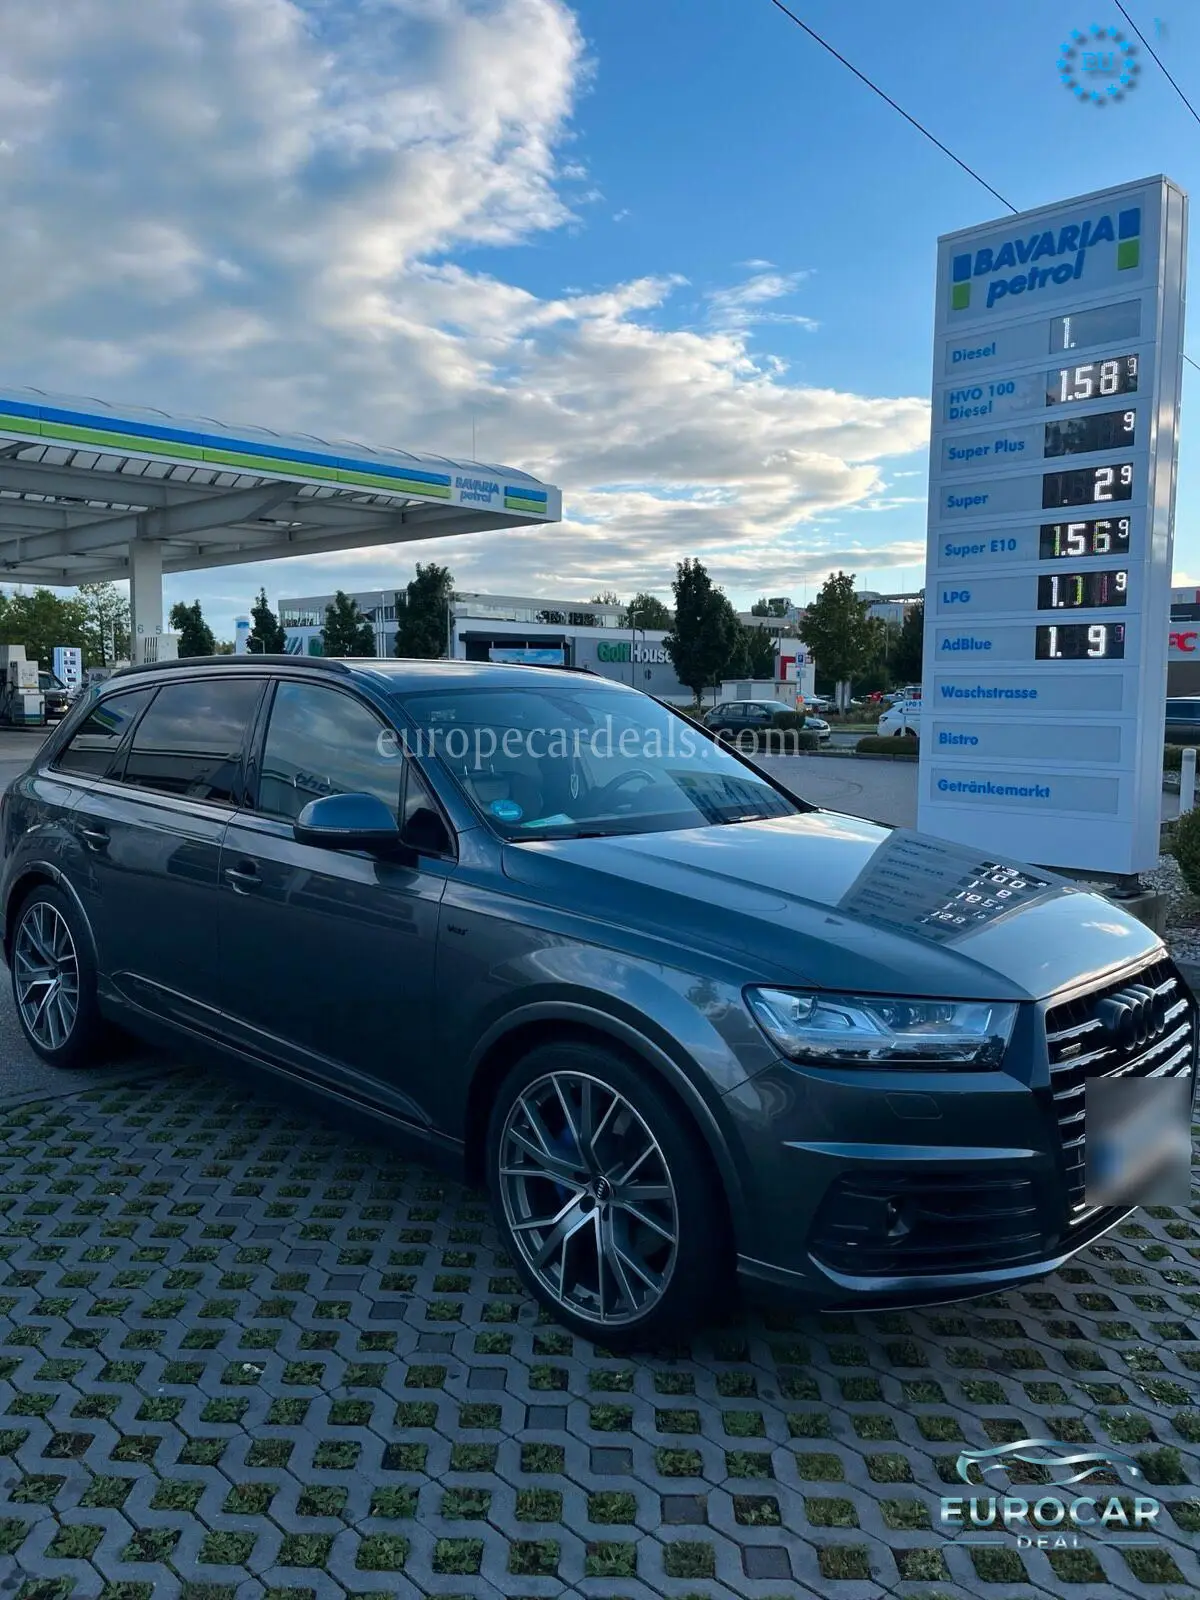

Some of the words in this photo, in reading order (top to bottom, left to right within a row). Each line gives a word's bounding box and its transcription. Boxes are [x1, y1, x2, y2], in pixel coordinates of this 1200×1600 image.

[973, 215, 1115, 276] BAVARIA
[986, 249, 1086, 308] petrol
[952, 342, 996, 363] Diesel
[950, 387, 983, 405] HVO
[988, 381, 1015, 397] 100
[950, 404, 993, 420] Diesel
[1123, 411, 1135, 432] 9
[947, 445, 990, 460] Super
[994, 439, 1025, 454] Plus
[455, 476, 500, 495] BAVARIA
[946, 493, 989, 509] Super
[944, 542, 986, 557] Super
[990, 538, 1017, 552] E10
[943, 590, 971, 603] LPG
[137, 624, 144, 634] 6
[941, 637, 992, 651] AdBlue
[941, 685, 1038, 699] Waschstrasse
[939, 732, 979, 746] Bistro
[937, 778, 1050, 798] Getränkemarkt
